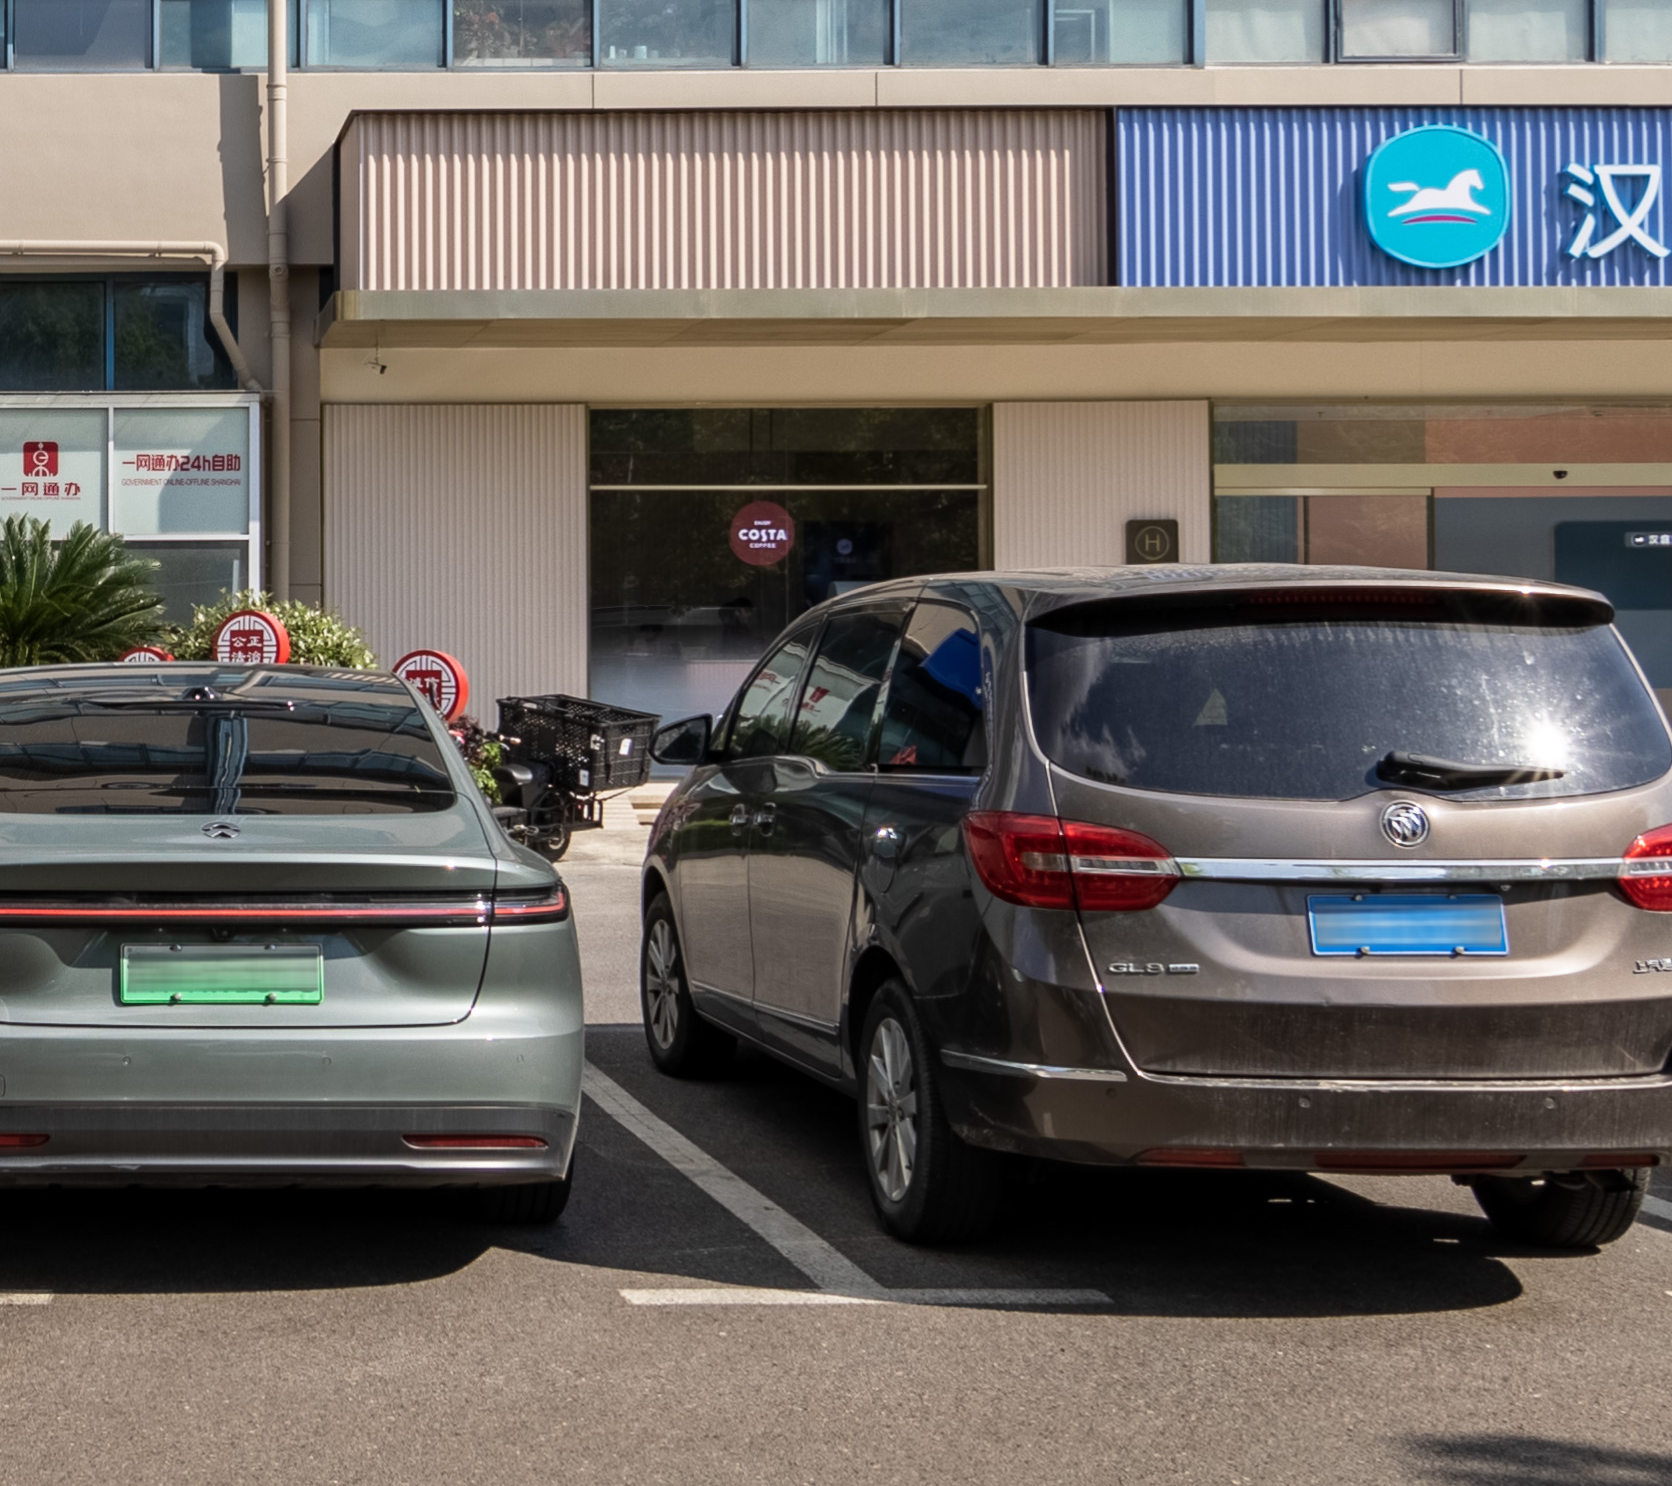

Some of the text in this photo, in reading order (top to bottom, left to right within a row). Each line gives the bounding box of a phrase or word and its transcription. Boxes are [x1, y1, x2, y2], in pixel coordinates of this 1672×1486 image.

[122, 454, 241, 472] 一网通办24h自助
[1, 481, 81, 497] 一网通办
[738, 528, 787, 542] COSTA
[231, 635, 263, 648] 公正
[1108, 962, 1164, 973] GL8
